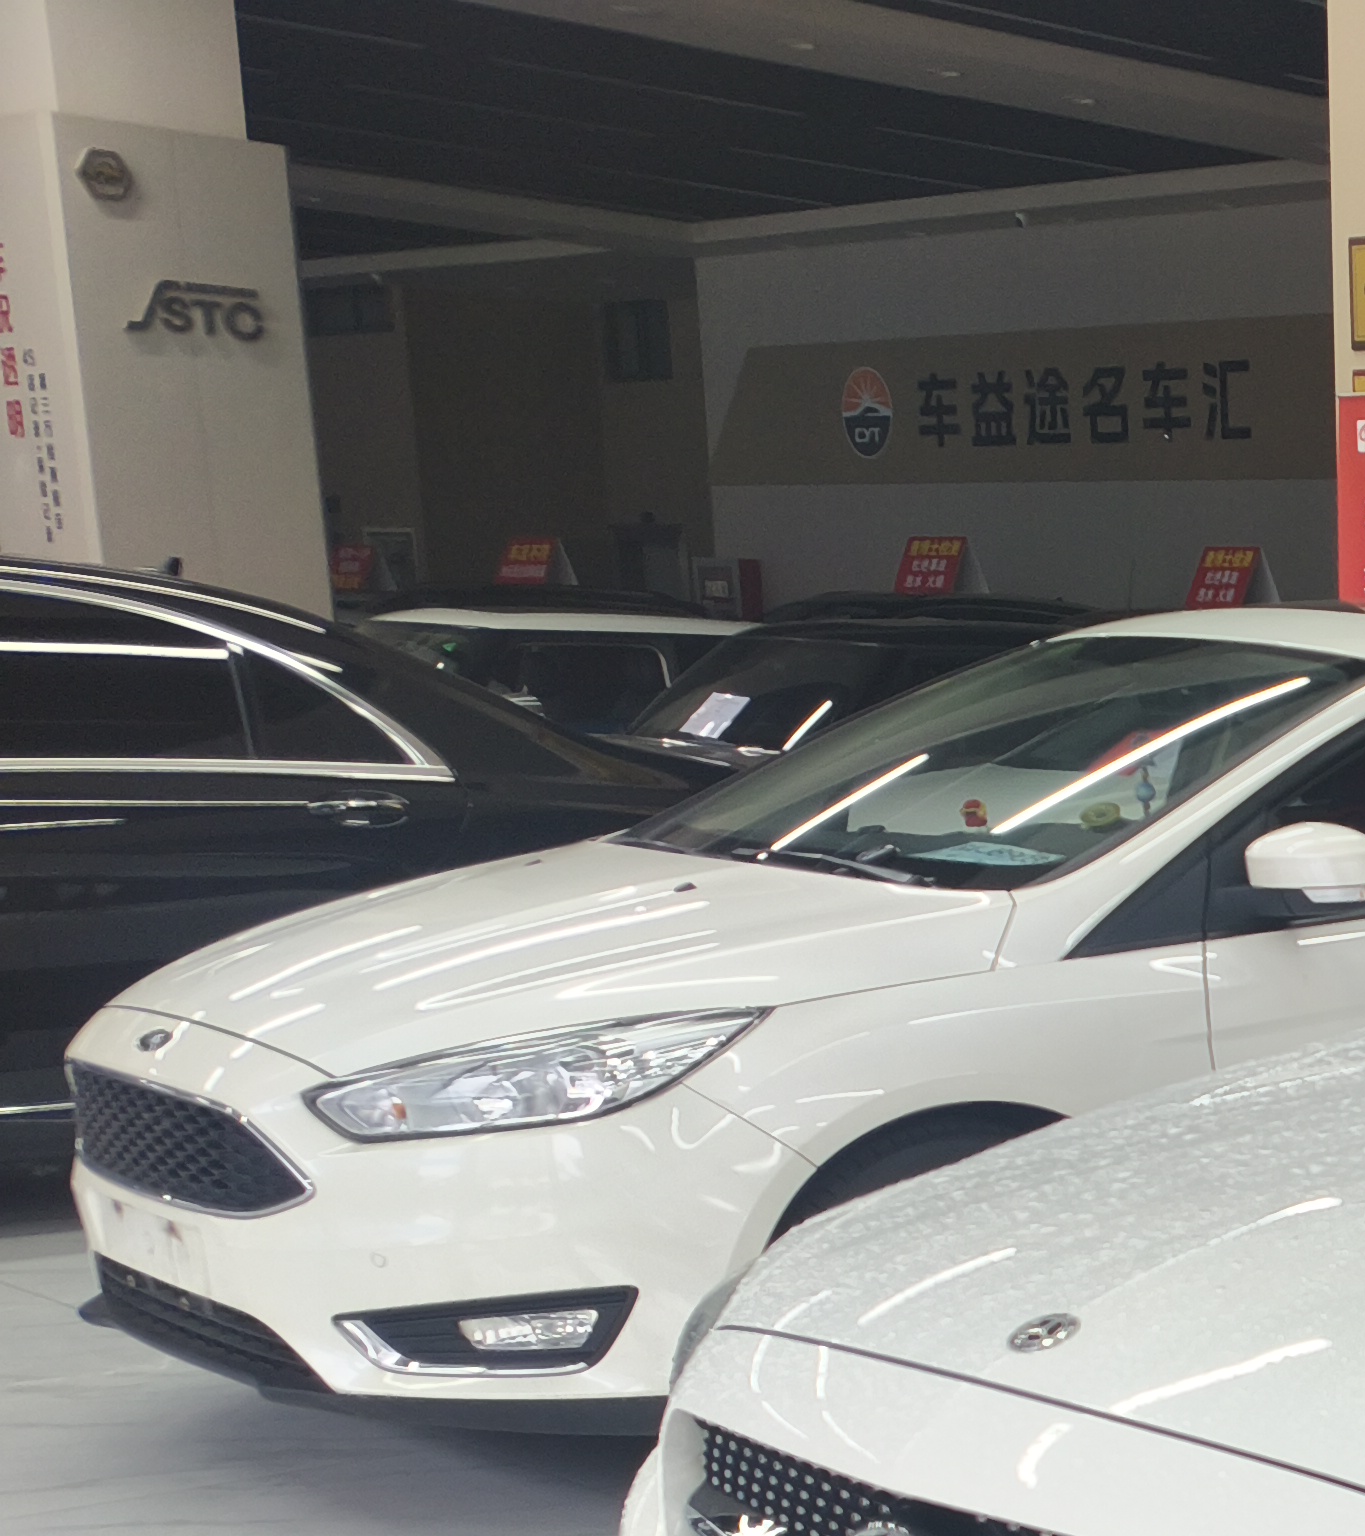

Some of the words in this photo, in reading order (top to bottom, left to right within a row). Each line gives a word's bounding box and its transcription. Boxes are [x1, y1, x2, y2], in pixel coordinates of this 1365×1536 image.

[917, 359, 1252, 447] 车益途名车汇
